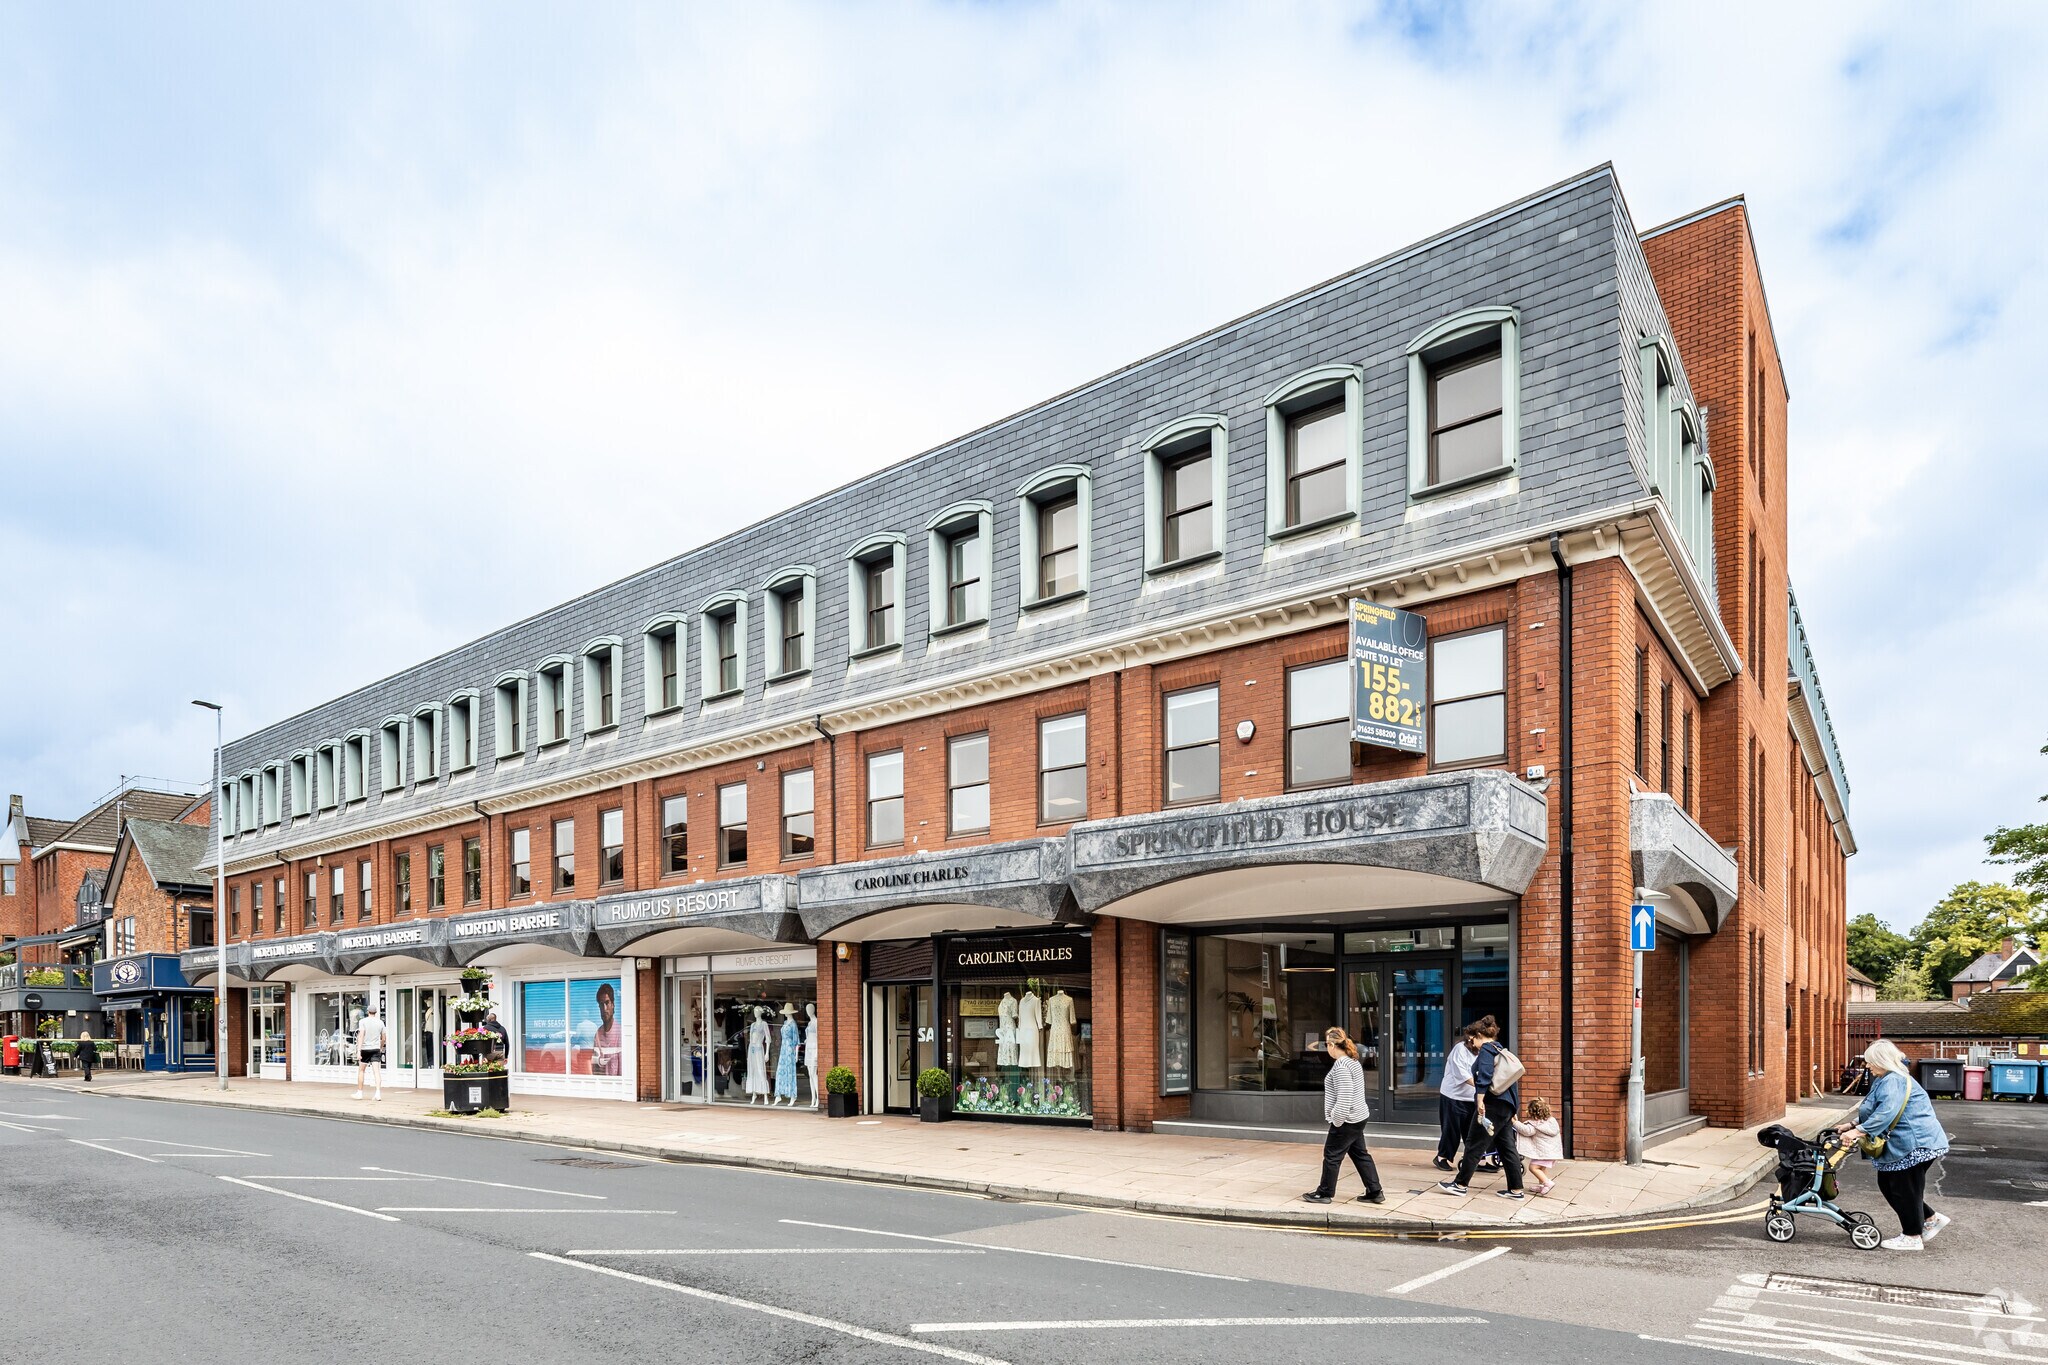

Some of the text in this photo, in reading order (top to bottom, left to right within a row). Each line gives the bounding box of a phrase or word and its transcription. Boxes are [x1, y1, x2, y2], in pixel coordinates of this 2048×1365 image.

[1355, 602, 1396, 620] SPRINGFIELD
[1355, 612, 1378, 625] HOUSE
[1356, 636, 1424, 660] AVAILABLE OFFICE
[1356, 649, 1404, 668] SUITE TO LET
[1369, 691, 1414, 726] 882
[1357, 724, 1374, 734] 01625
[1398, 732, 1417, 744] Orbit
[1115, 802, 1405, 857] SPRINGFIELD HOUSE
[854, 866, 969, 891] CAROLINE CHARLES
[612, 890, 739, 921] RUMPUS RESORT
[455, 913, 560, 937] NORTON BARRIE
[342, 929, 422, 949] NORTON BARRIE
[253, 942, 317, 958] NORTON BARRIE
[958, 947, 1072, 966] CAROLINE CHARLES
[735, 953, 792, 967] RUMPUS RESORT
[547, 1019, 566, 1028] SEASO
[917, 1027, 934, 1042] SA
